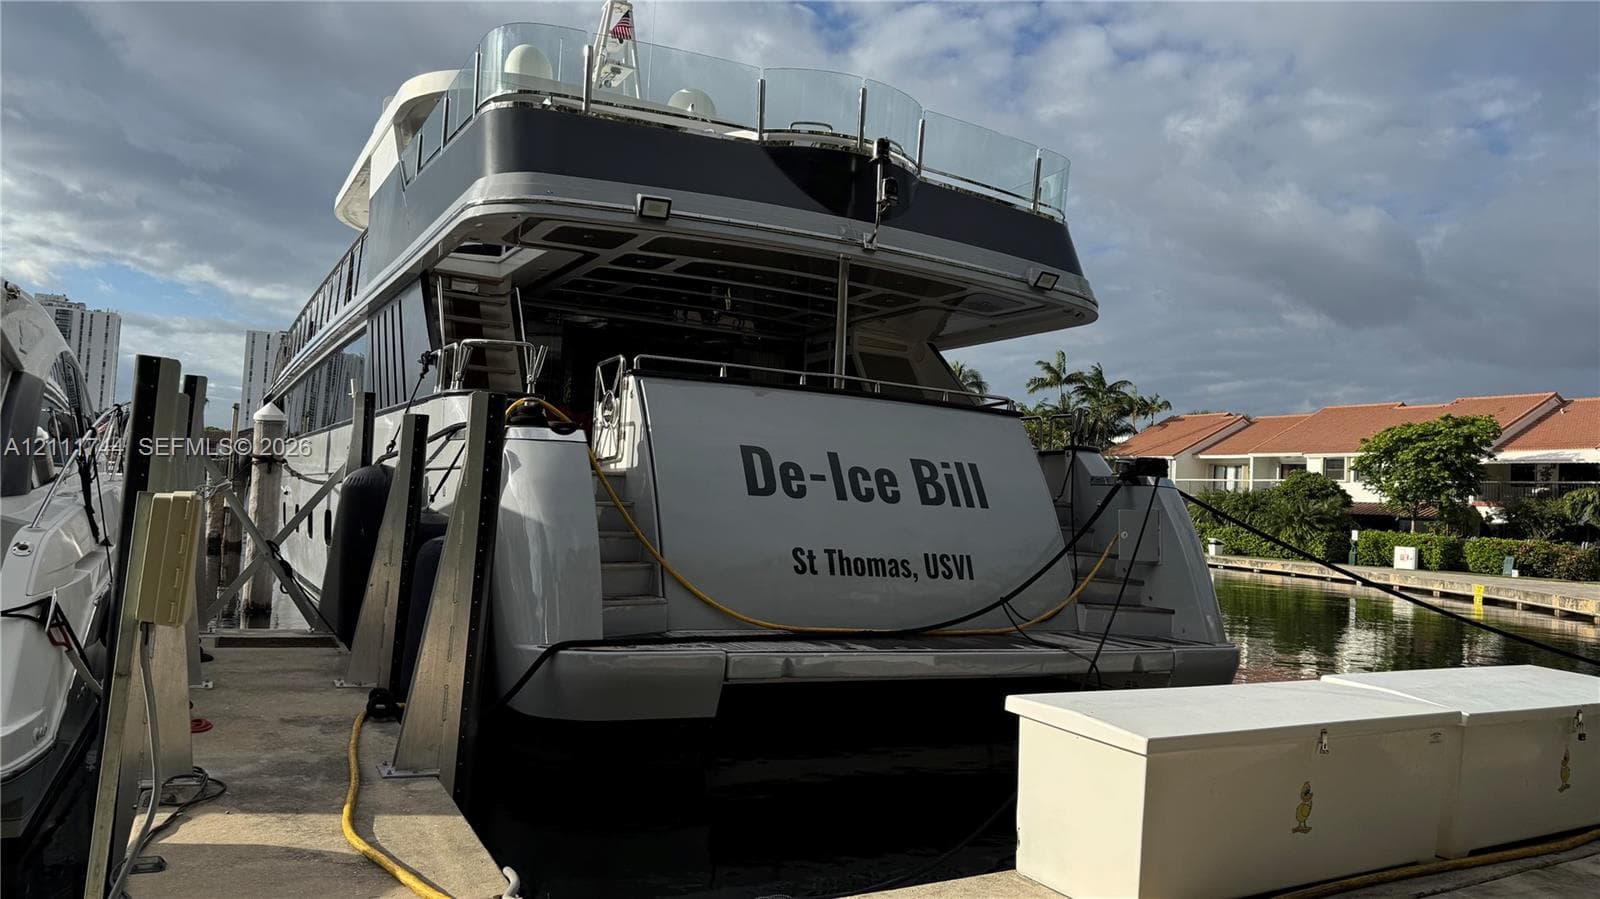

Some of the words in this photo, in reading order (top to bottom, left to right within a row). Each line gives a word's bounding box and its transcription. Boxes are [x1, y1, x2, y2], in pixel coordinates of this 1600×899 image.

[740, 444, 901, 505] De-Ice
[909, 458, 990, 509] Bill
[791, 547, 819, 576] St
[823, 548, 919, 583] Thomas,
[923, 553, 975, 580] USVI
